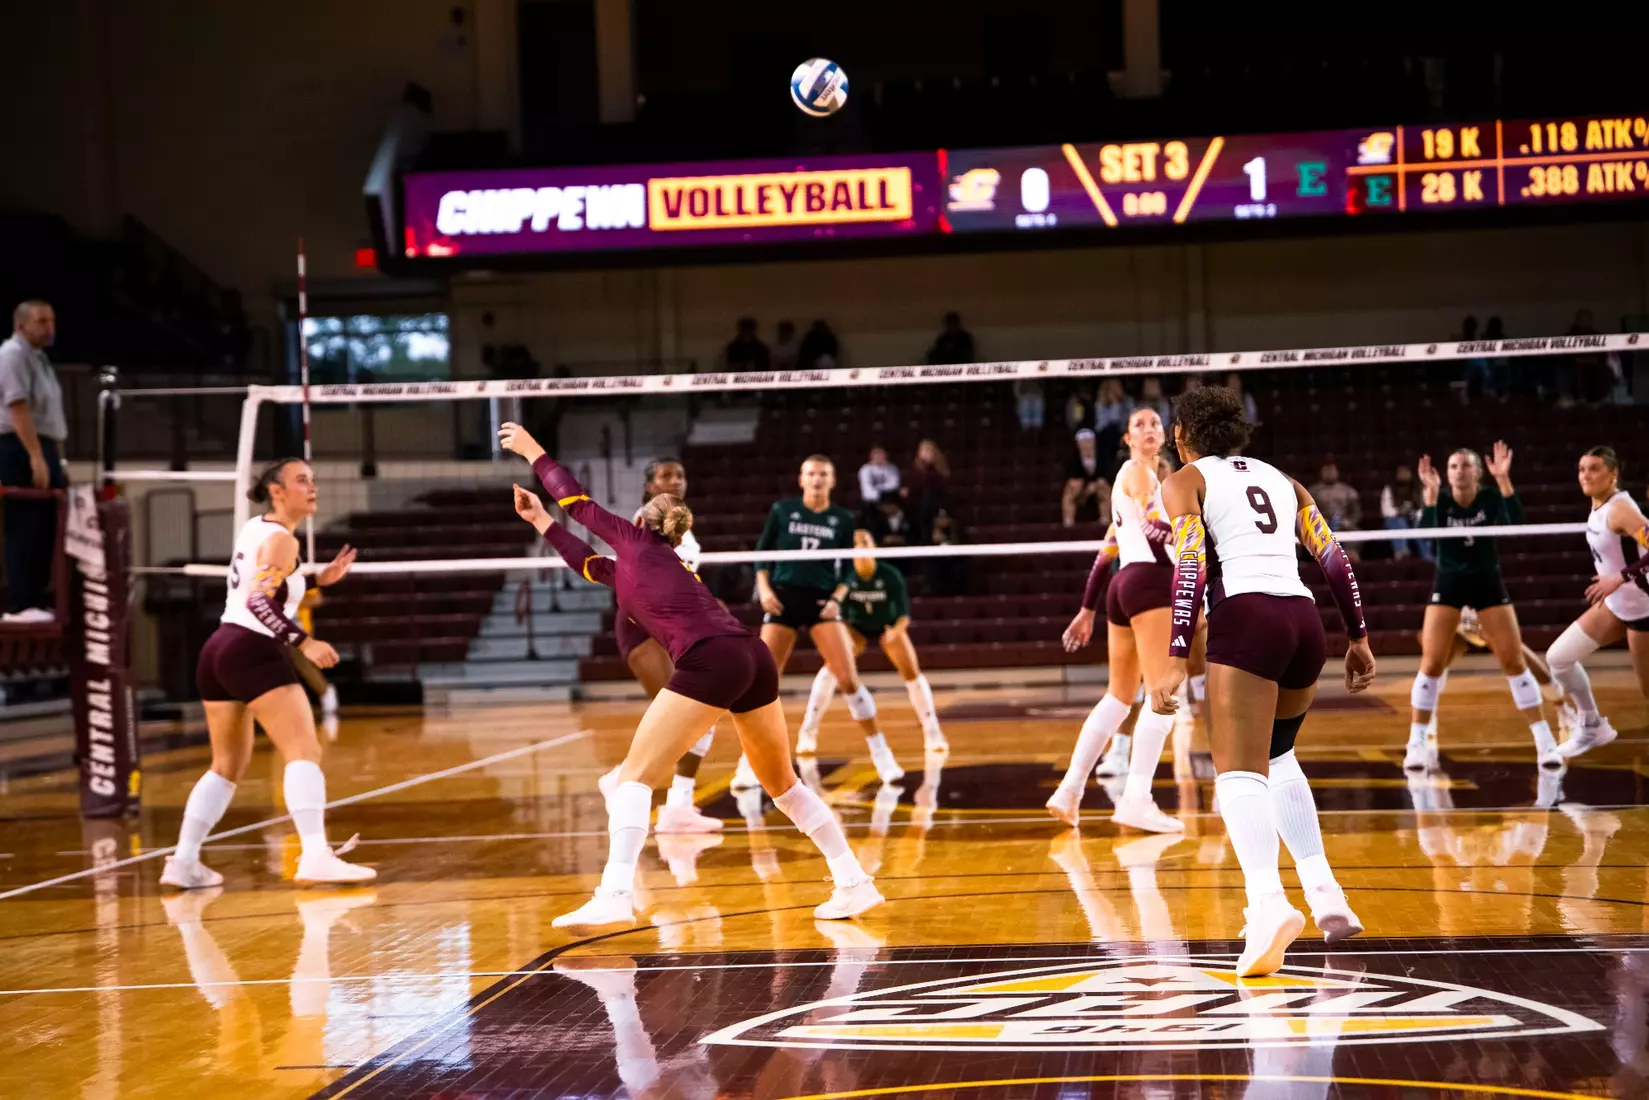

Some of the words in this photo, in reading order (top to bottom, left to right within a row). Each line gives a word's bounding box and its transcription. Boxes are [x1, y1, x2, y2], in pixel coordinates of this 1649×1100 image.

[1100, 143, 1159, 184] SET
[1164, 141, 1190, 181] 3
[1421, 128, 1454, 160] 19
[1460, 126, 1481, 158] K
[662, 176, 897, 219] VOLLEYBALL
[1020, 167, 1049, 212] 0
[1242, 156, 1267, 201] 1
[1296, 161, 1328, 197] E
[1365, 175, 1391, 206] E
[1463, 170, 1484, 201] K
[1456, 341, 1497, 353] CENTRAL
[1501, 338, 1548, 351] MICHIGAN
[1550, 336, 1606, 349] VOLLEYBALL
[1245, 485, 1278, 535] 9
[1173, 550, 1198, 627] CHIPPEWAS
[87, 678, 117, 797] CENTRAL
[1031, 1023, 1247, 1035] 1946
